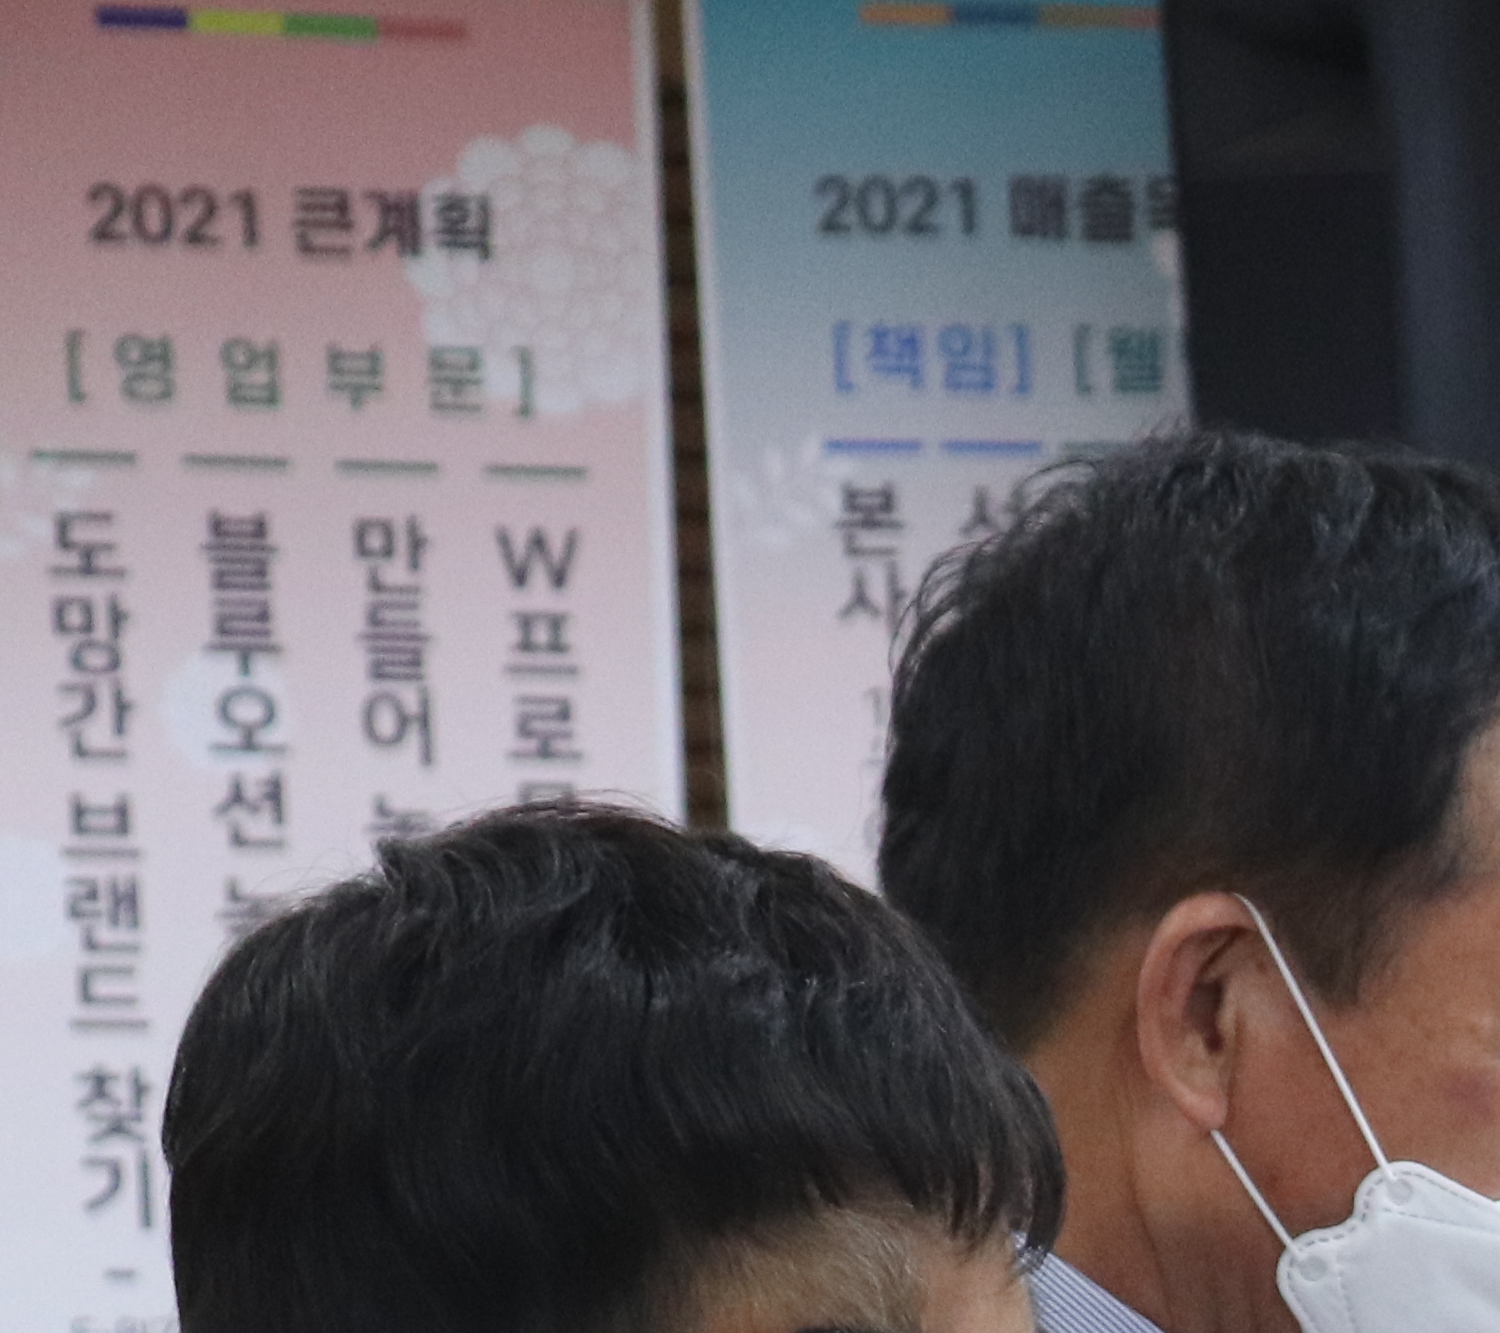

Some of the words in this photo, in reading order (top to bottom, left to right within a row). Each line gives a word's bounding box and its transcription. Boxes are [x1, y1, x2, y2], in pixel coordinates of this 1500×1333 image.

[88, 181, 260, 250] 2021
[294, 186, 494, 262] 큰계획
[814, 173, 978, 236] 2021
[48, 510, 134, 763] 도망간
[199, 508, 292, 850] 블루오션
[352, 514, 436, 767] 만들어
[57, 793, 152, 1031] 브랜드
[73, 1065, 154, 1230] 찾기
